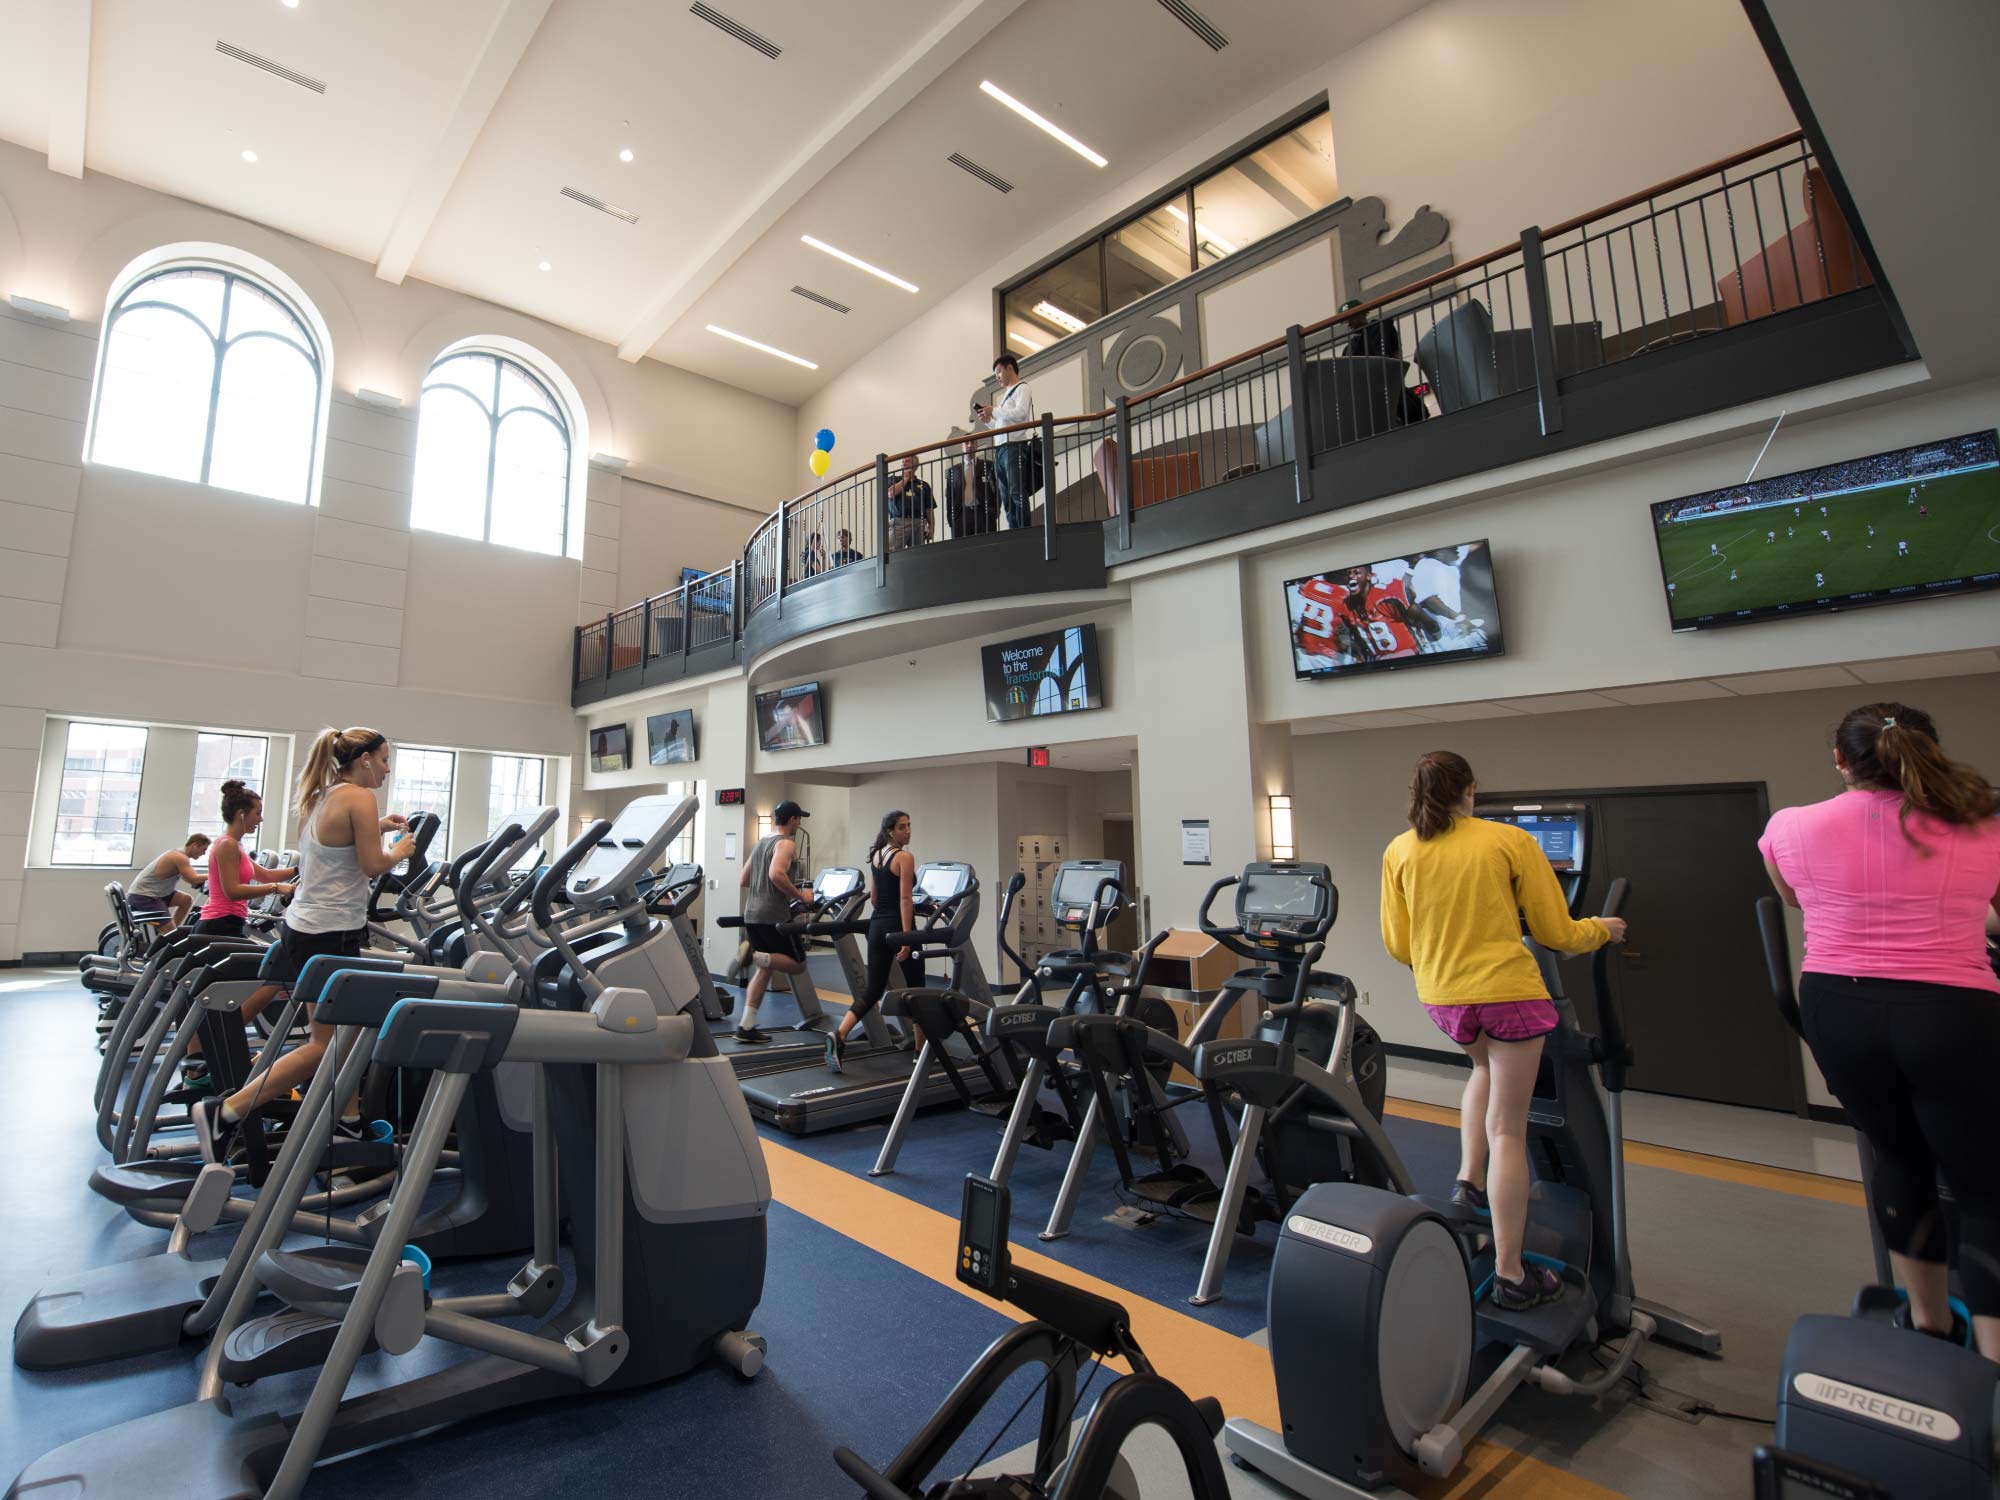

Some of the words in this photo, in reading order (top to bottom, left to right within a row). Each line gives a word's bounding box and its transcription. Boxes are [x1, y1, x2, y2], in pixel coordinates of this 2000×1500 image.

[1002, 646, 1043, 662] Welcome
[1003, 663, 1012, 674] to
[1013, 660, 1028, 673] the
[1012, 1012, 1037, 1025] CYBEX
[1227, 1047, 1253, 1064] CYBEX
[1309, 1222, 1360, 1249] PRECOR
[1830, 1384, 1936, 1431] PRECOR
